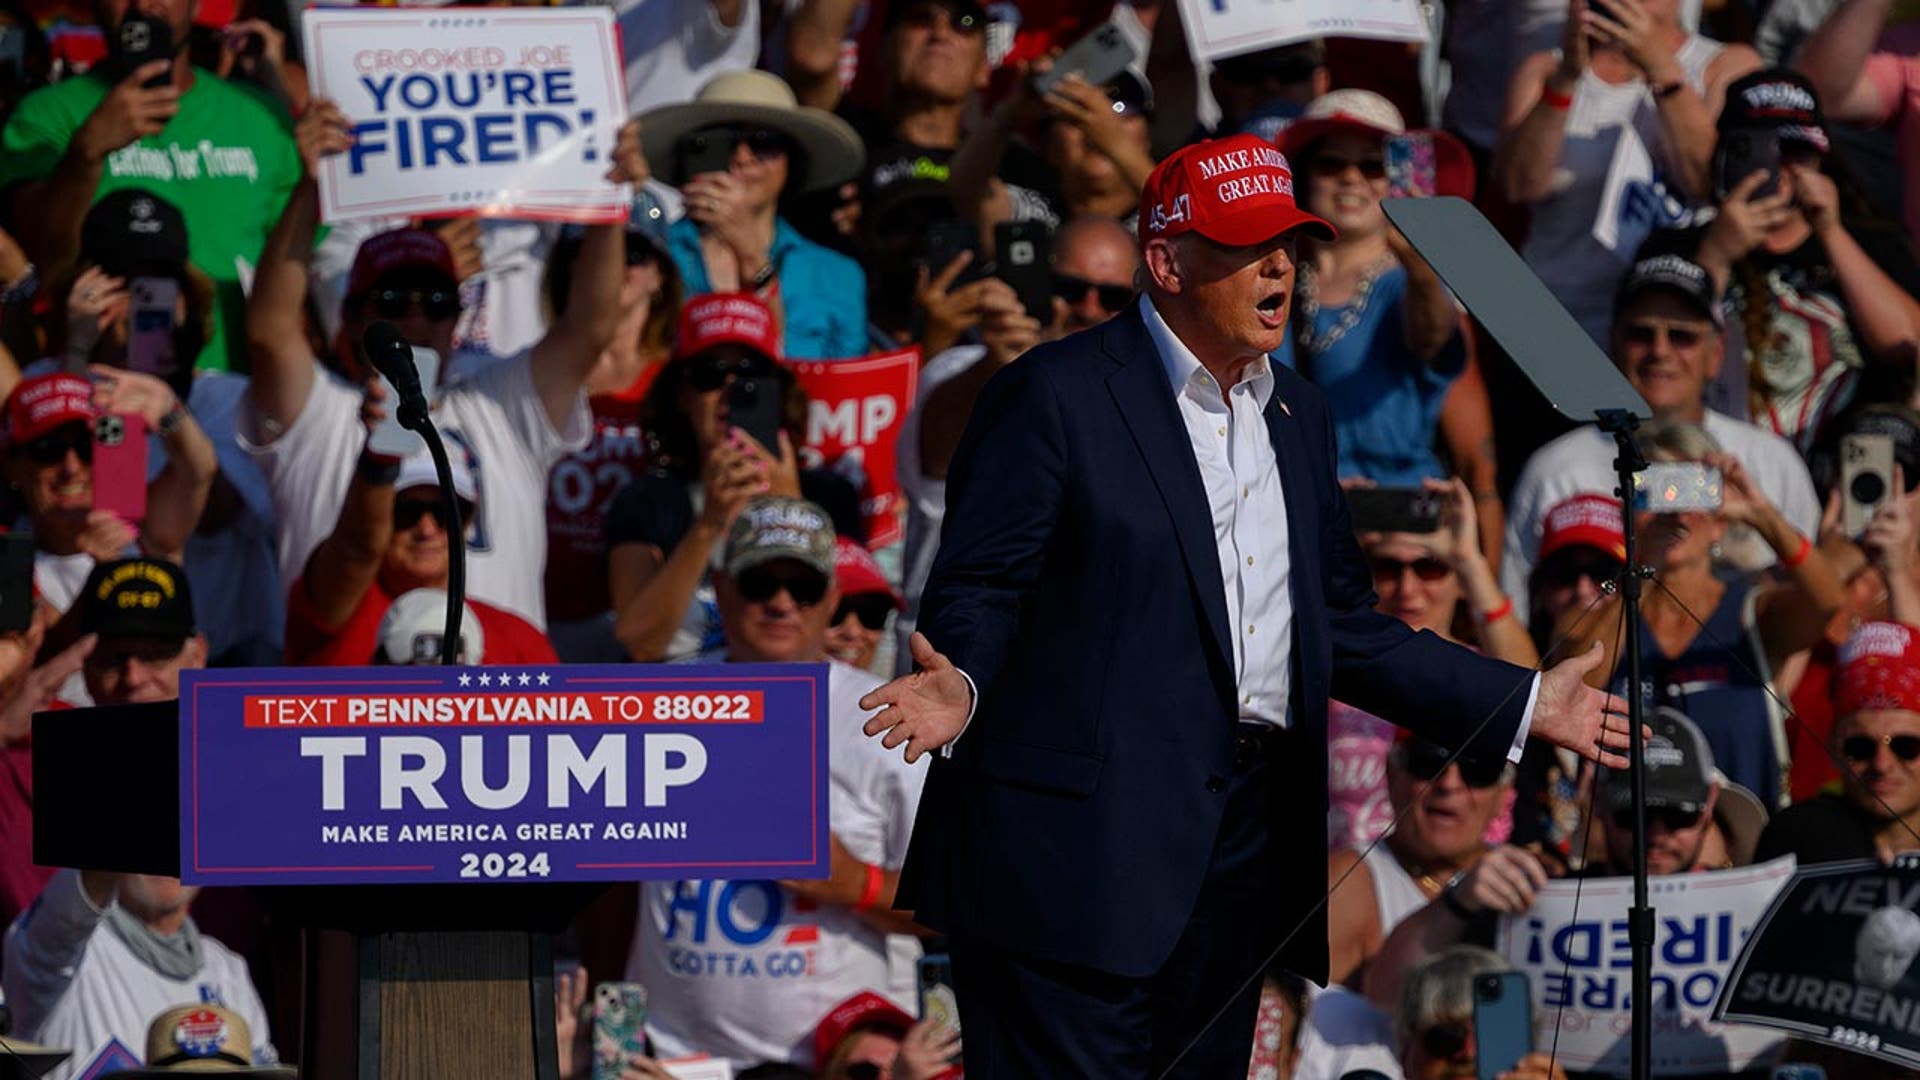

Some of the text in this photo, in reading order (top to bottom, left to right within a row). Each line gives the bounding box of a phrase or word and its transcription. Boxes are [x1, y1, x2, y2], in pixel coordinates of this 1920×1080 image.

[354, 46, 571, 72] CROOKED JOE
[361, 71, 575, 111] YOU'RE
[1741, 81, 1815, 111] TRUMP
[350, 110, 596, 175] FIRED!
[1198, 149, 1252, 180] MAKE
[1218, 174, 1272, 203] GREAT
[1149, 193, 1191, 232] 45-47
[258, 695, 750, 724] TEXT PENNSYLVANIA TO 88022
[300, 733, 708, 811] TRUMP
[322, 822, 687, 843] MAKE AMERICA GREAT AGAIN!
[460, 852, 550, 878] 2024
[1527, 913, 1735, 968] IRED!
[669, 950, 758, 977] GOTTA
[1832, 1024, 1881, 1051] 2024
